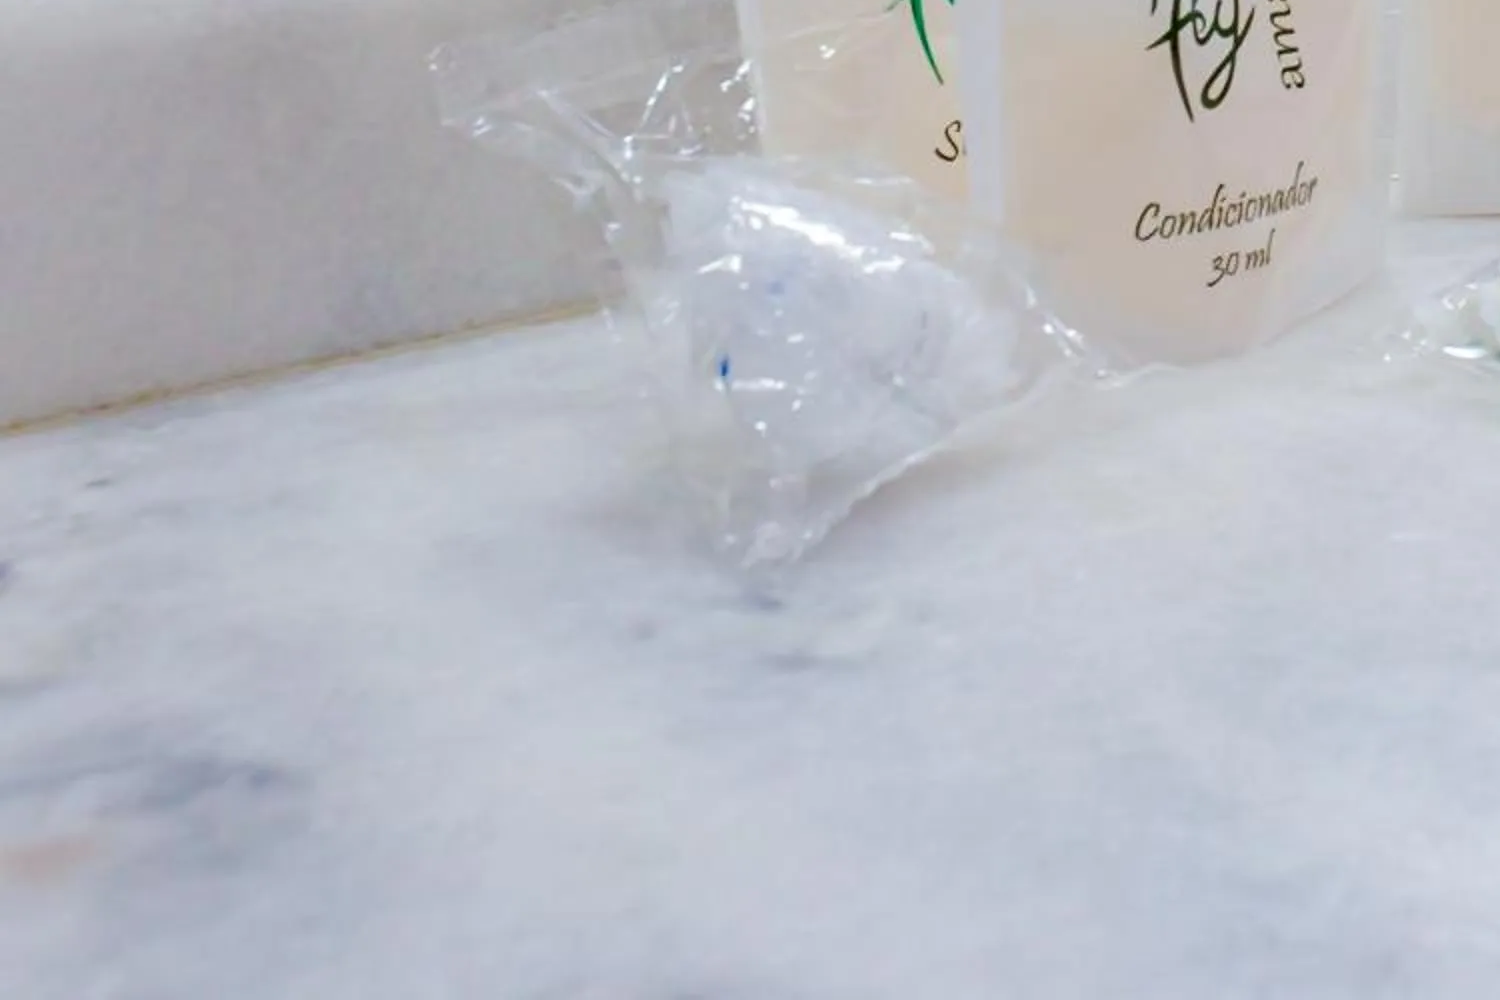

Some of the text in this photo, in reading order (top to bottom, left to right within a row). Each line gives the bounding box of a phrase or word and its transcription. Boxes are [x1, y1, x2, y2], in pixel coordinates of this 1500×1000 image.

[1134, 160, 1319, 242] Condicionador
[1206, 227, 1276, 288] 30 ml
